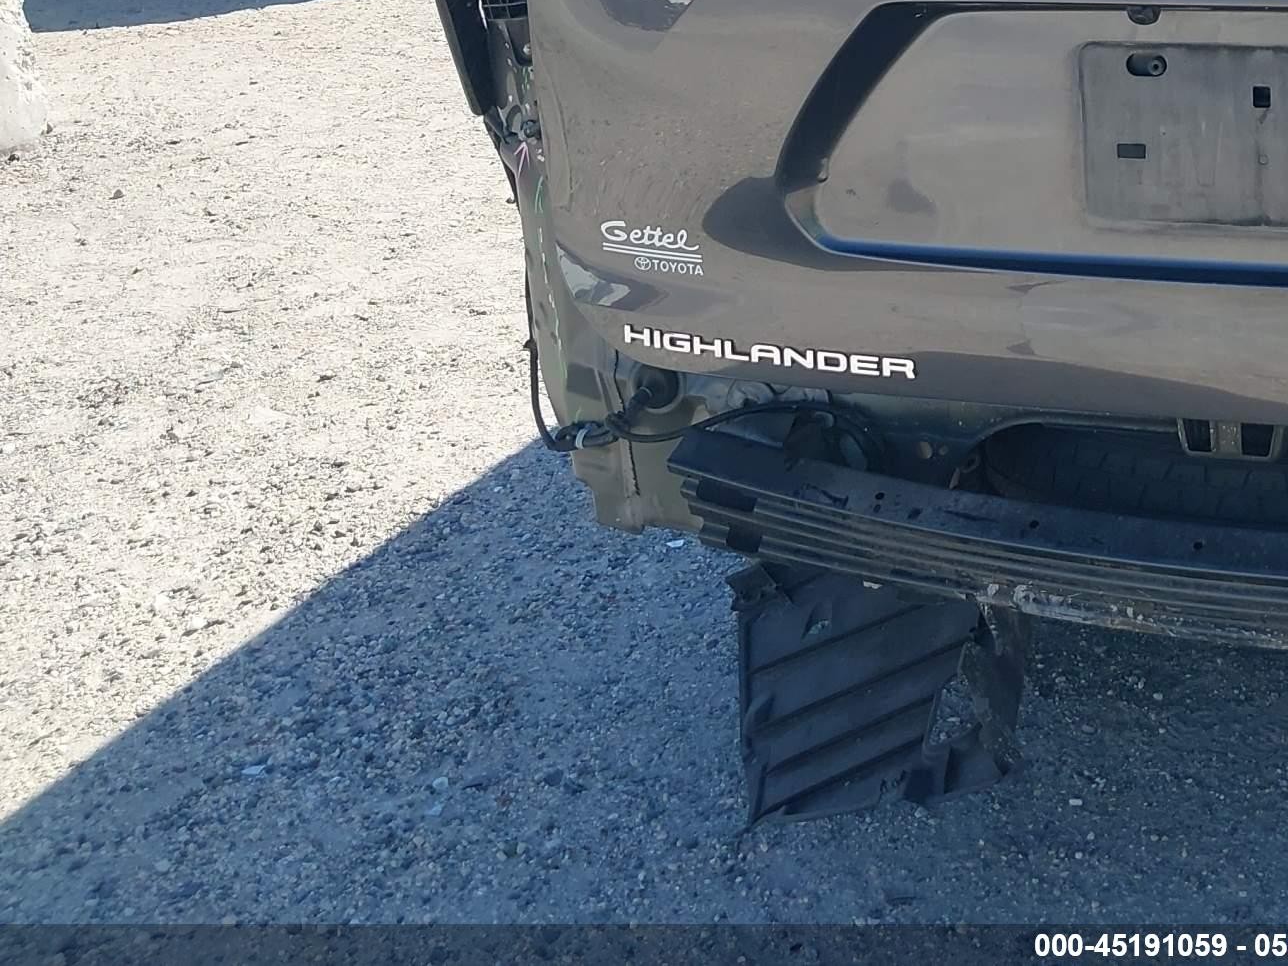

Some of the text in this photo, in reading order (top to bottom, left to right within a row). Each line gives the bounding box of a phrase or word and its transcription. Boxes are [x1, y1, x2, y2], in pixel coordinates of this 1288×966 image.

[600, 220, 700, 251] Gettel
[652, 258, 704, 276] TOYOTA
[623, 323, 916, 380] HIGHLANDER
